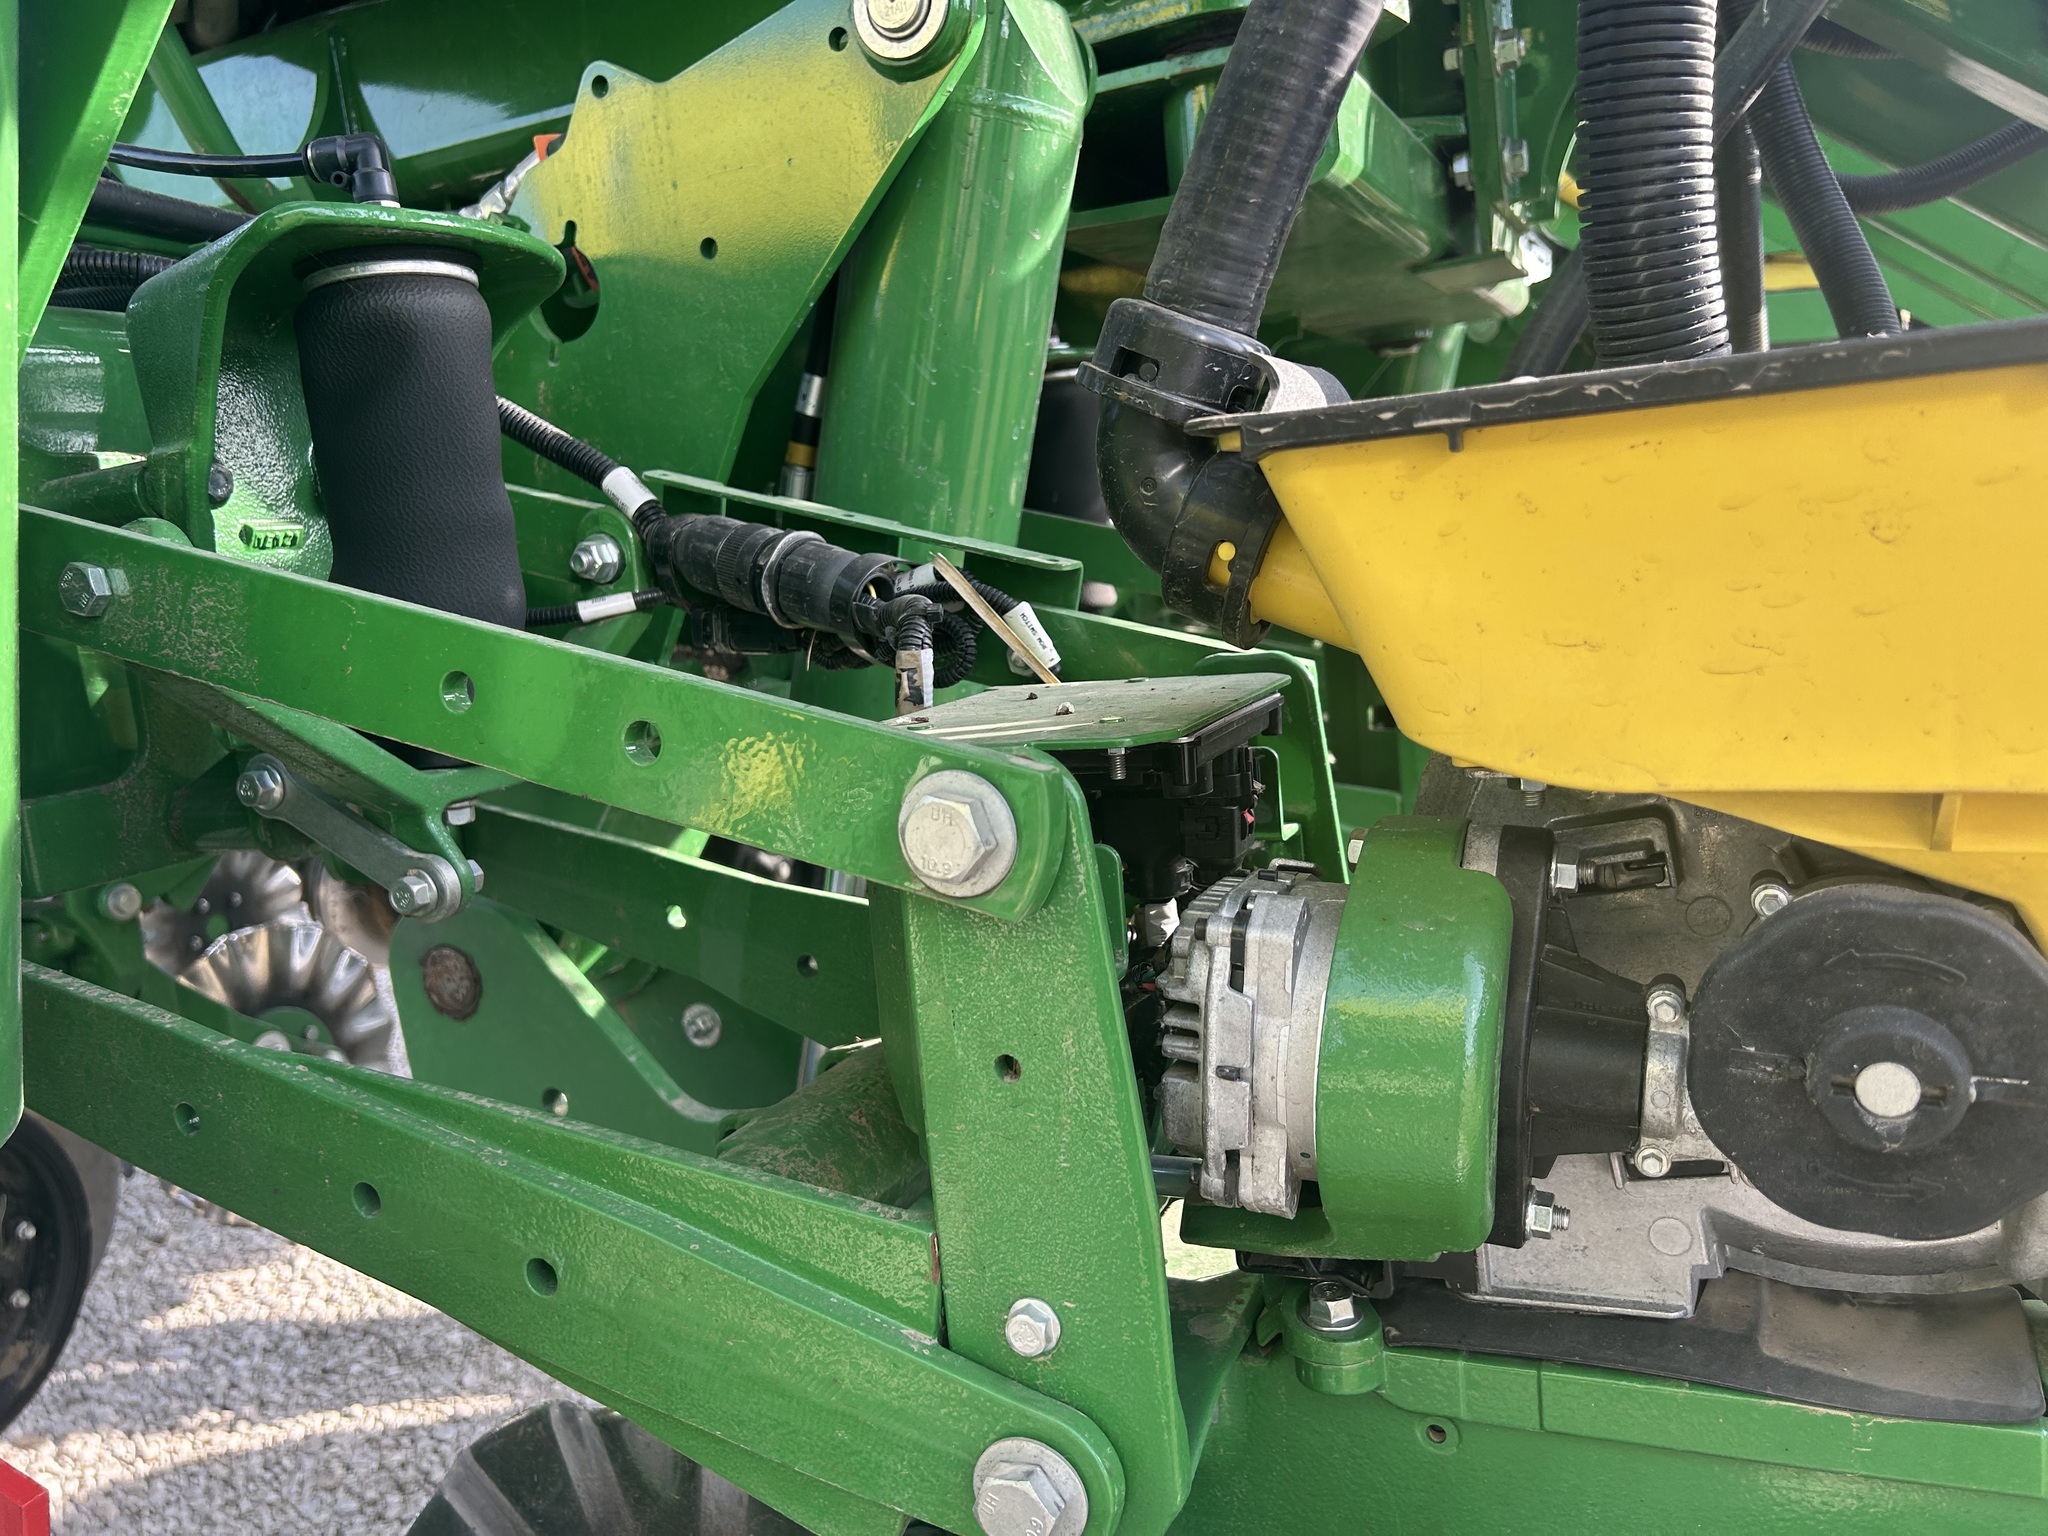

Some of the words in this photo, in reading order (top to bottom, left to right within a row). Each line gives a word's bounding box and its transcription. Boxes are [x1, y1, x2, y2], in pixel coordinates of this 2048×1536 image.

[1020, 612, 1039, 638] SWITCH
[930, 806, 953, 827] UH
[921, 855, 953, 876] 10.9
[981, 1492, 1000, 1515] UH
[1025, 1516, 1044, 1536] 0.9
